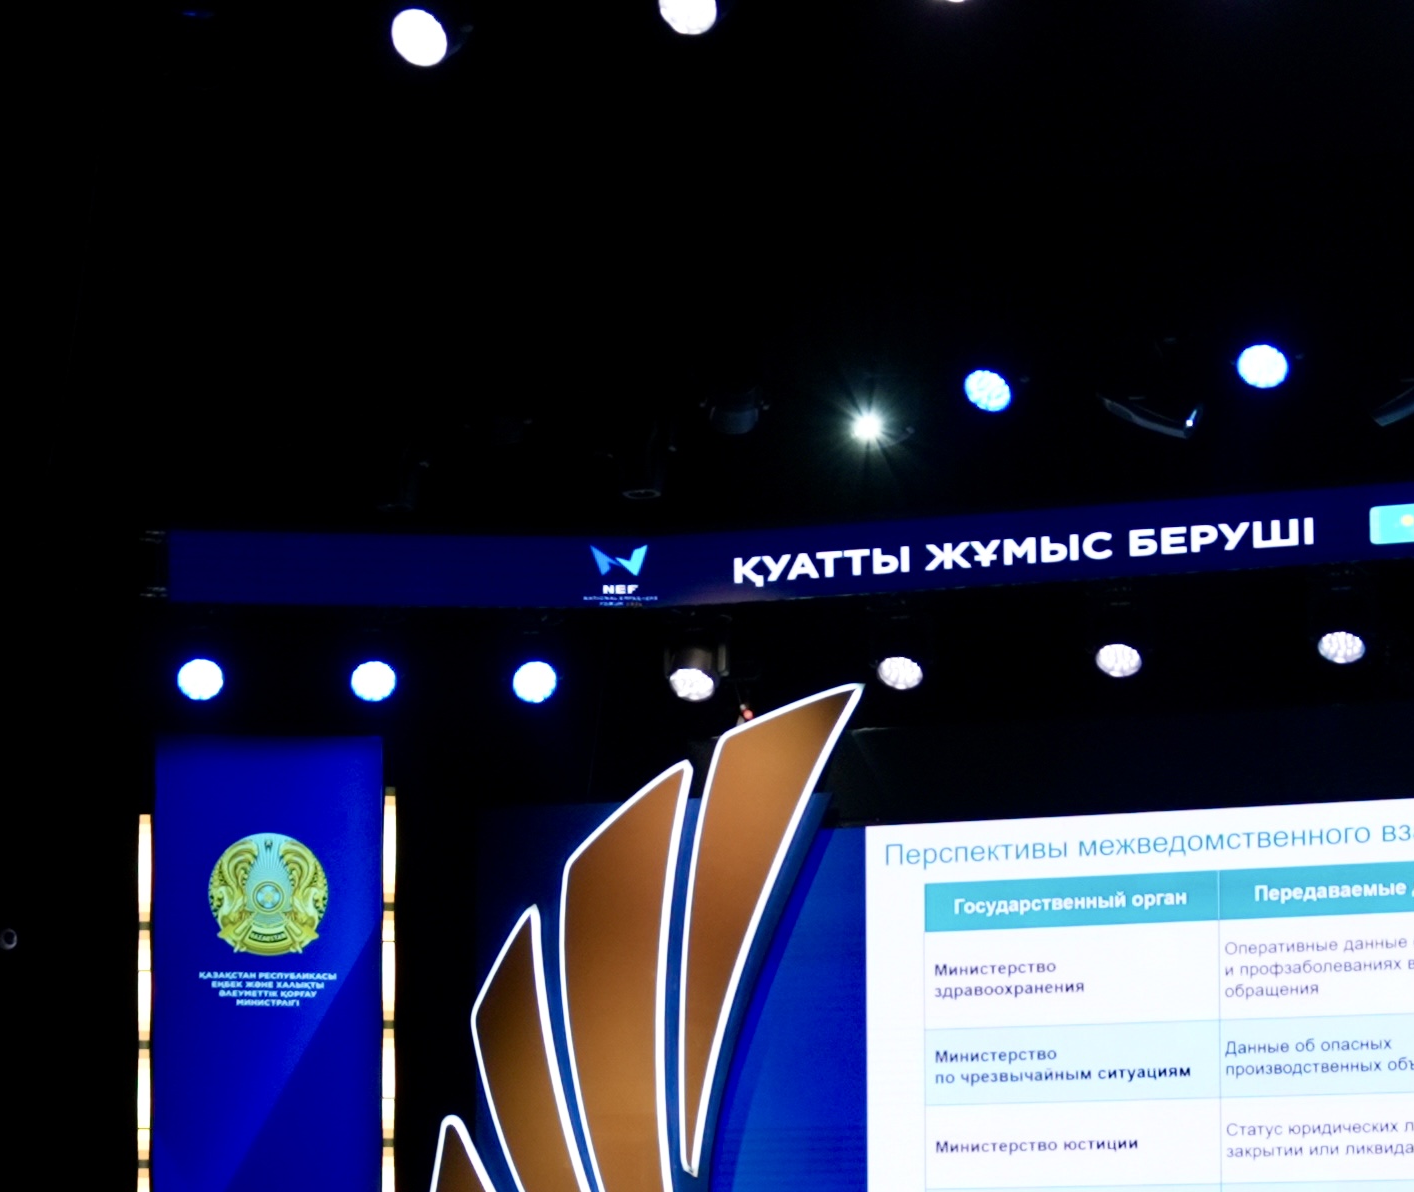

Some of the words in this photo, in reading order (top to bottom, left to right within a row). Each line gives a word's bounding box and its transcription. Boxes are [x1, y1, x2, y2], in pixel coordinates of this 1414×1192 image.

[733, 546, 910, 587] ҚУАТТЫ
[925, 531, 1112, 571] ЖҰМЫС
[1128, 517, 1315, 557] БЕРУШІ
[603, 584, 639, 595] NEF
[885, 841, 1068, 870] Перспективы
[1078, 826, 1371, 857] межведомственного
[1254, 881, 1407, 904] Передаваемые
[953, 891, 1127, 917] Государственный
[1132, 890, 1188, 912] орган
[1224, 941, 1338, 957] Оперативные
[1343, 937, 1407, 952] данные
[934, 960, 1057, 976] Министерство
[1225, 965, 1234, 977] и
[1239, 959, 1402, 981] профзаболеваниях
[934, 980, 1085, 999] здравоохранения
[1224, 983, 1319, 1000] обращения
[934, 1048, 1057, 1065] Министерство
[1224, 1040, 1290, 1058] Данные
[1295, 1038, 1315, 1053] об
[1321, 1038, 1392, 1052] опасных
[935, 1071, 955, 1085] по
[960, 1066, 1092, 1086] чрезвычайным
[1097, 1065, 1191, 1081] ситуациям
[1225, 1059, 1382, 1078] производственных
[1226, 1123, 1283, 1139] Статус
[1288, 1121, 1399, 1138] юридических
[935, 1139, 1058, 1155] Министерство
[1063, 1138, 1138, 1153] юстиции
[1226, 1145, 1304, 1160] закрытии
[1309, 1144, 1339, 1156] или
